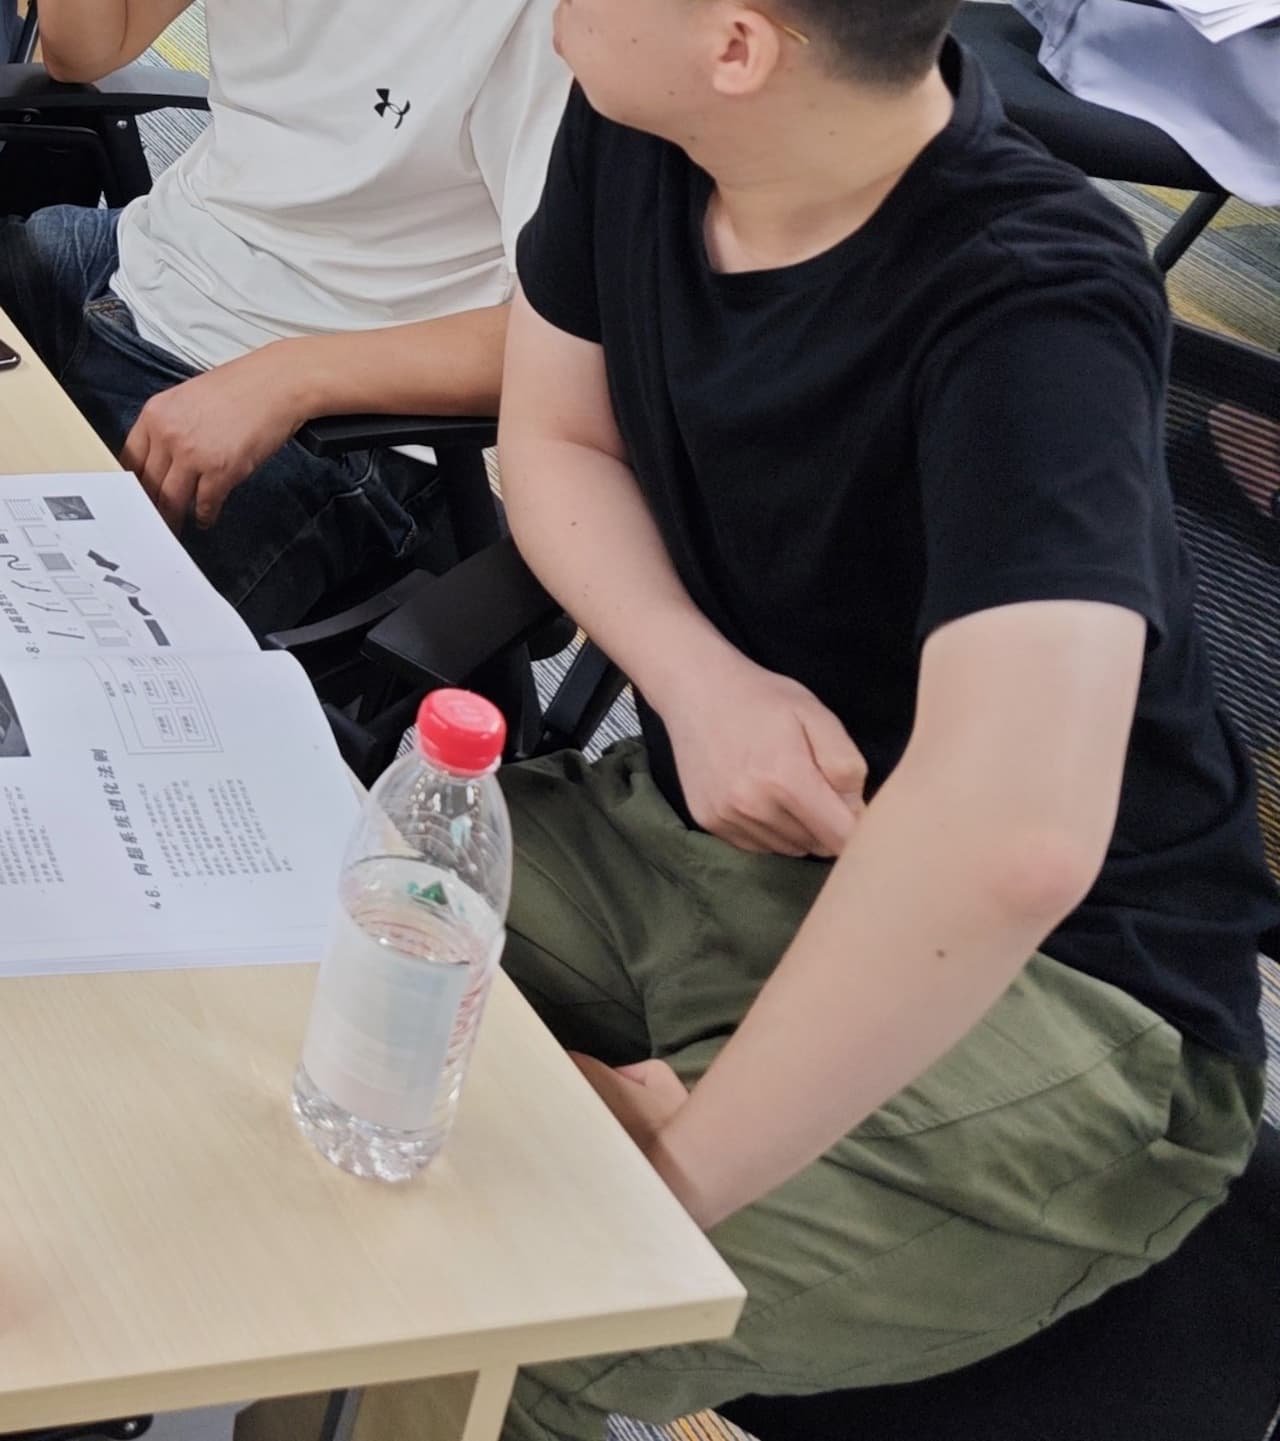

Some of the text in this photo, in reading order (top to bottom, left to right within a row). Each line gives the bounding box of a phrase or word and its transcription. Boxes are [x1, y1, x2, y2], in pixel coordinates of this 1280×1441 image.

[90, 748, 152, 876] 向超系统进化法则
